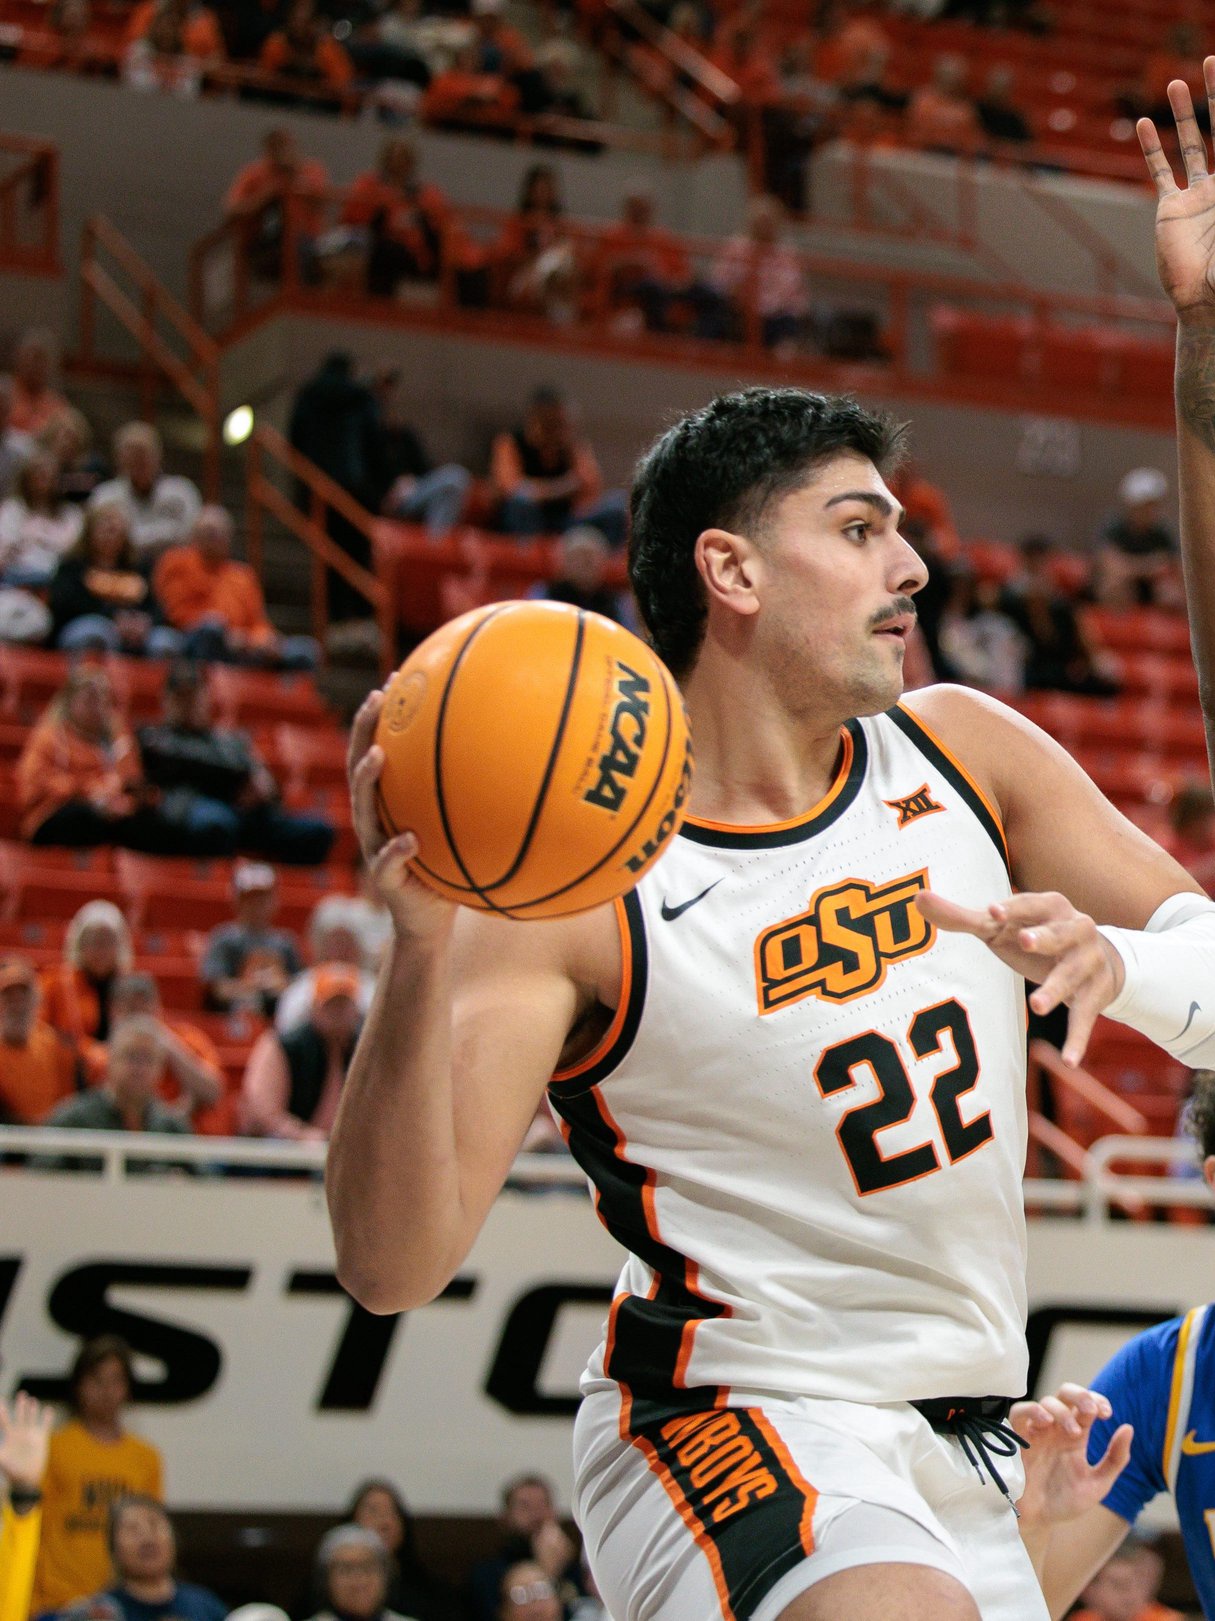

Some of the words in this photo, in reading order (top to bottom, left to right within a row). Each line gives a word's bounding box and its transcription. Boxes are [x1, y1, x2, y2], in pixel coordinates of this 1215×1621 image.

[583, 660, 652, 813] NCAA
[885, 785, 944, 827] XII
[754, 867, 938, 1016] OSU
[813, 996, 996, 1198] 22
